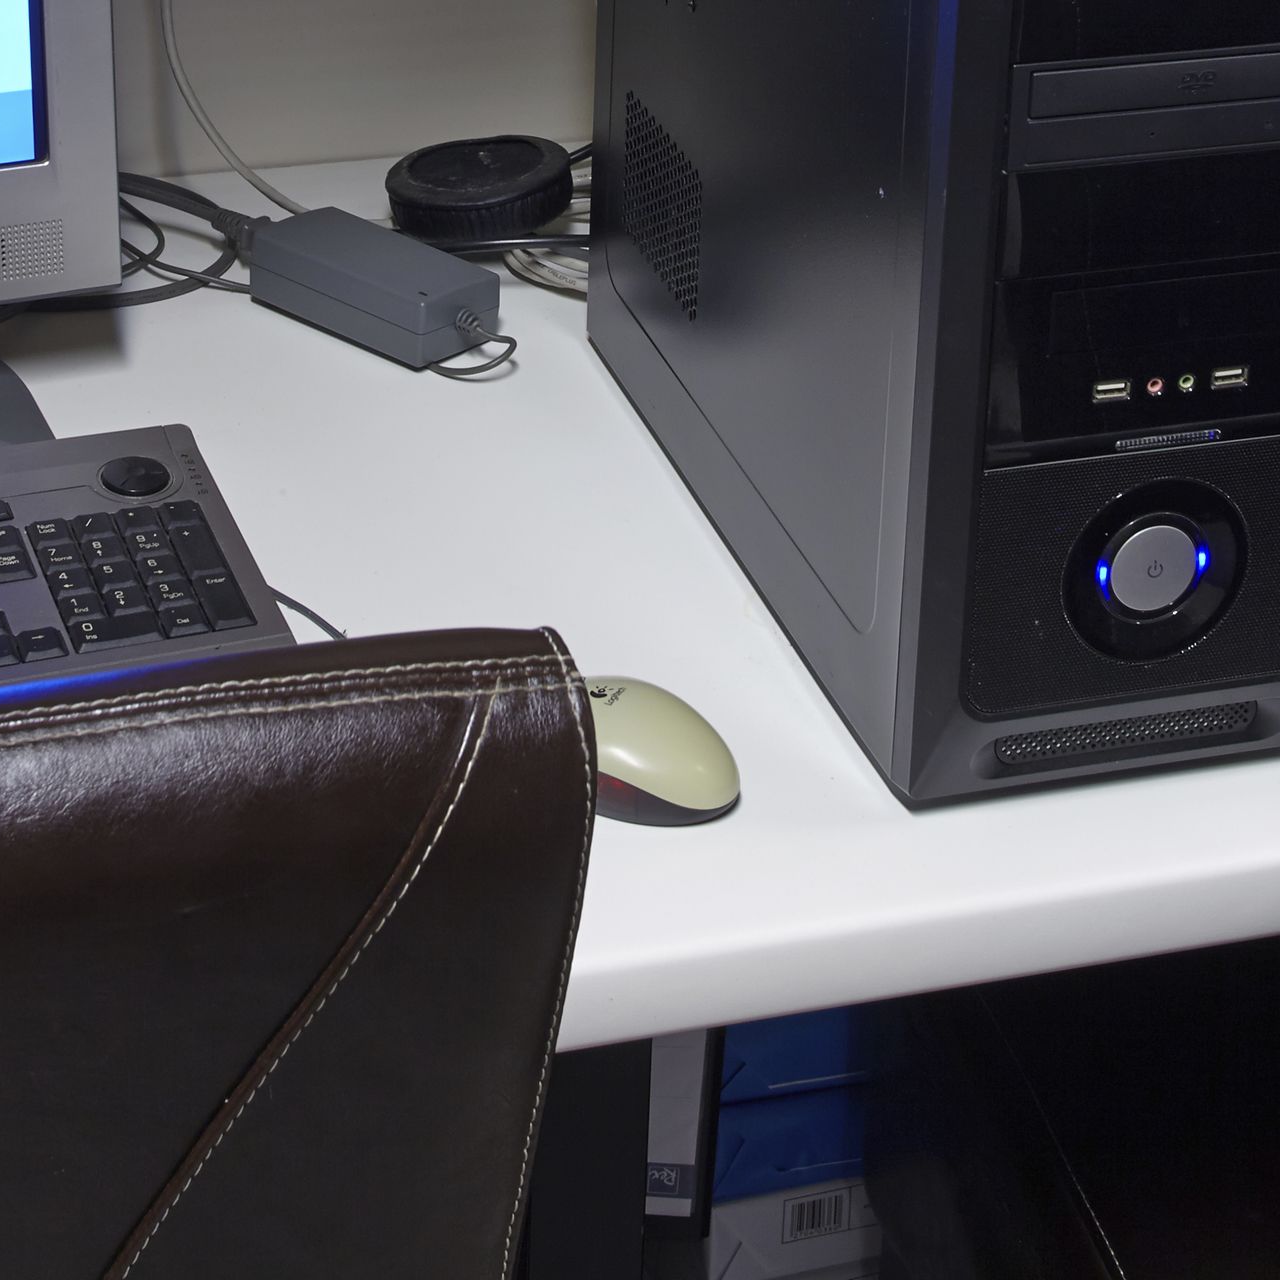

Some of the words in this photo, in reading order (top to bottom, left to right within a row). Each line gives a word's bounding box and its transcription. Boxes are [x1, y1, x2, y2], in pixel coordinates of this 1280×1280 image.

[136, 535, 146, 543] 9
[92, 541, 102, 549] 8
[48, 548, 56, 556] 7
[147, 559, 157, 567] 6
[103, 565, 113, 573] 5
[59, 572, 68, 580] 4
[205, 576, 226, 584] Enter
[604, 687, 626, 706] Logitech
